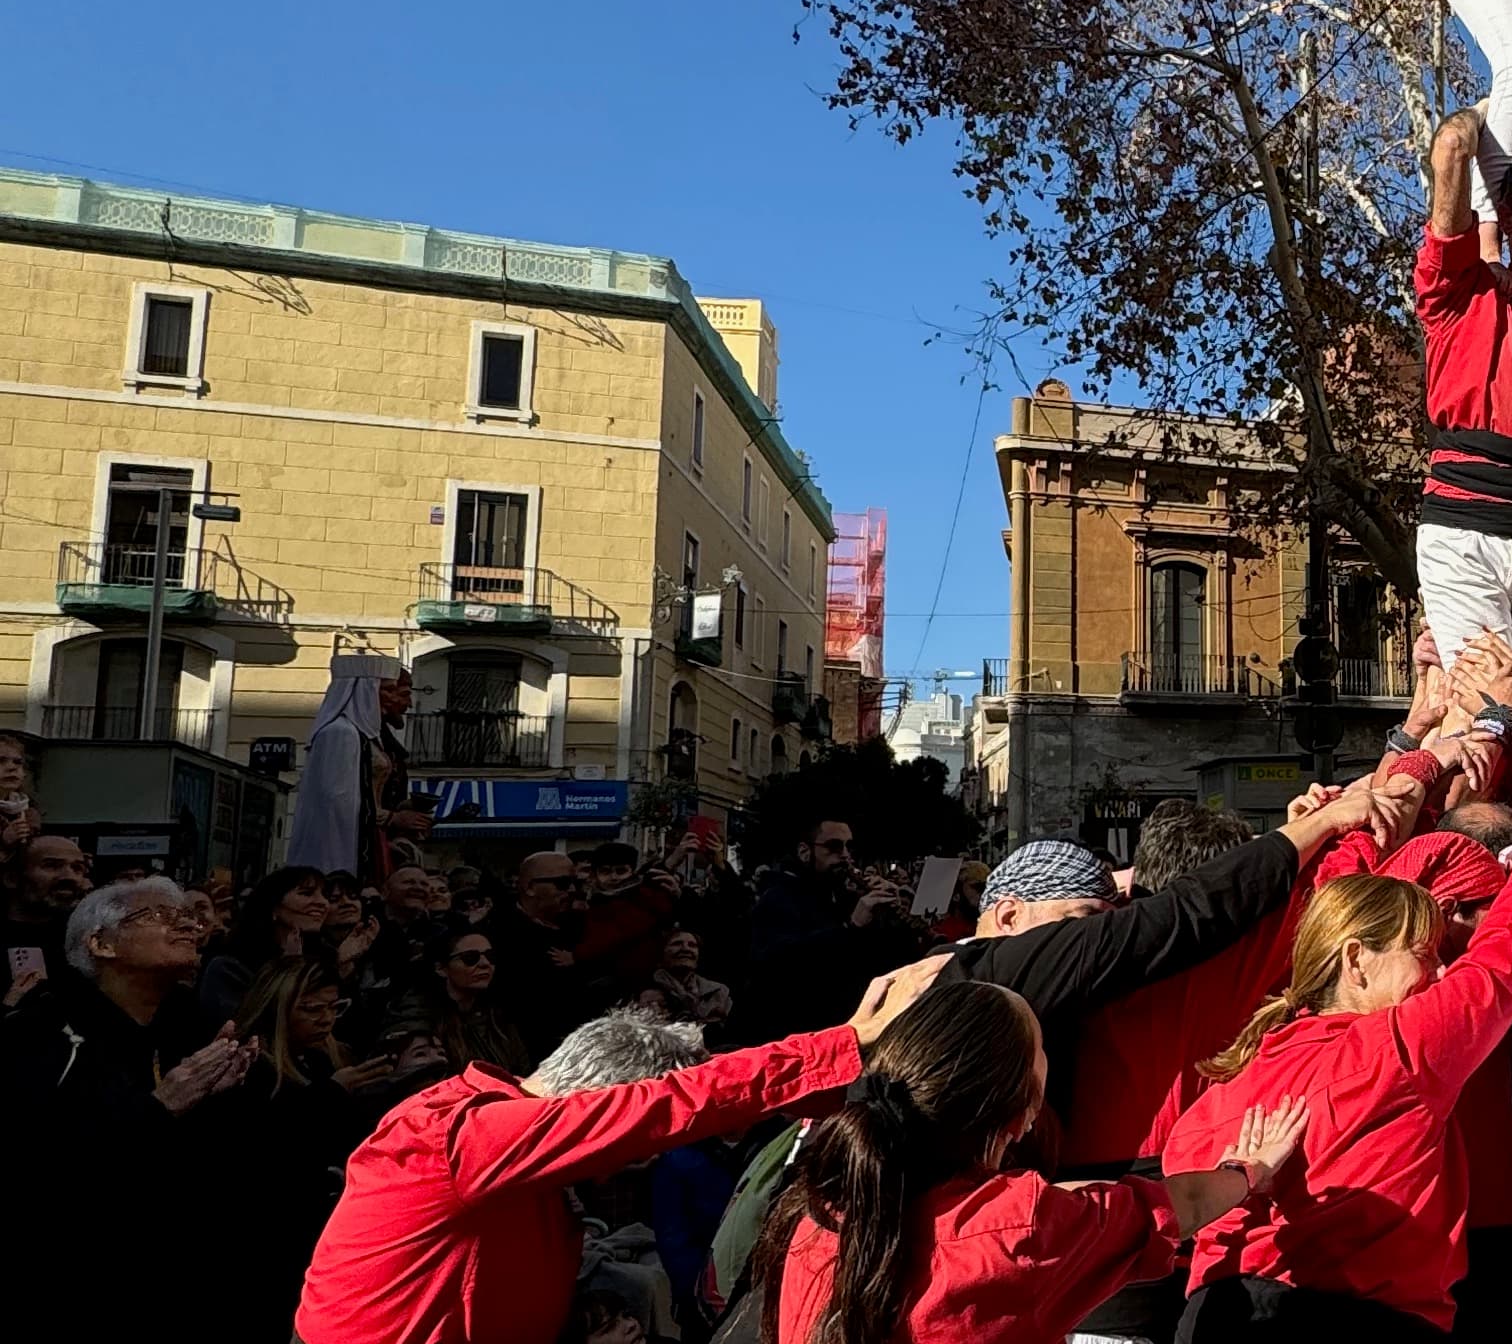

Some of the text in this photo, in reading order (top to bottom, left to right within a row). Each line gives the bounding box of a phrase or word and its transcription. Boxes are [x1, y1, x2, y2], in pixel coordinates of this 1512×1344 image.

[252, 743, 287, 753] ATM
[1254, 767, 1294, 778] ONCE
[565, 794, 616, 803] Hermanos
